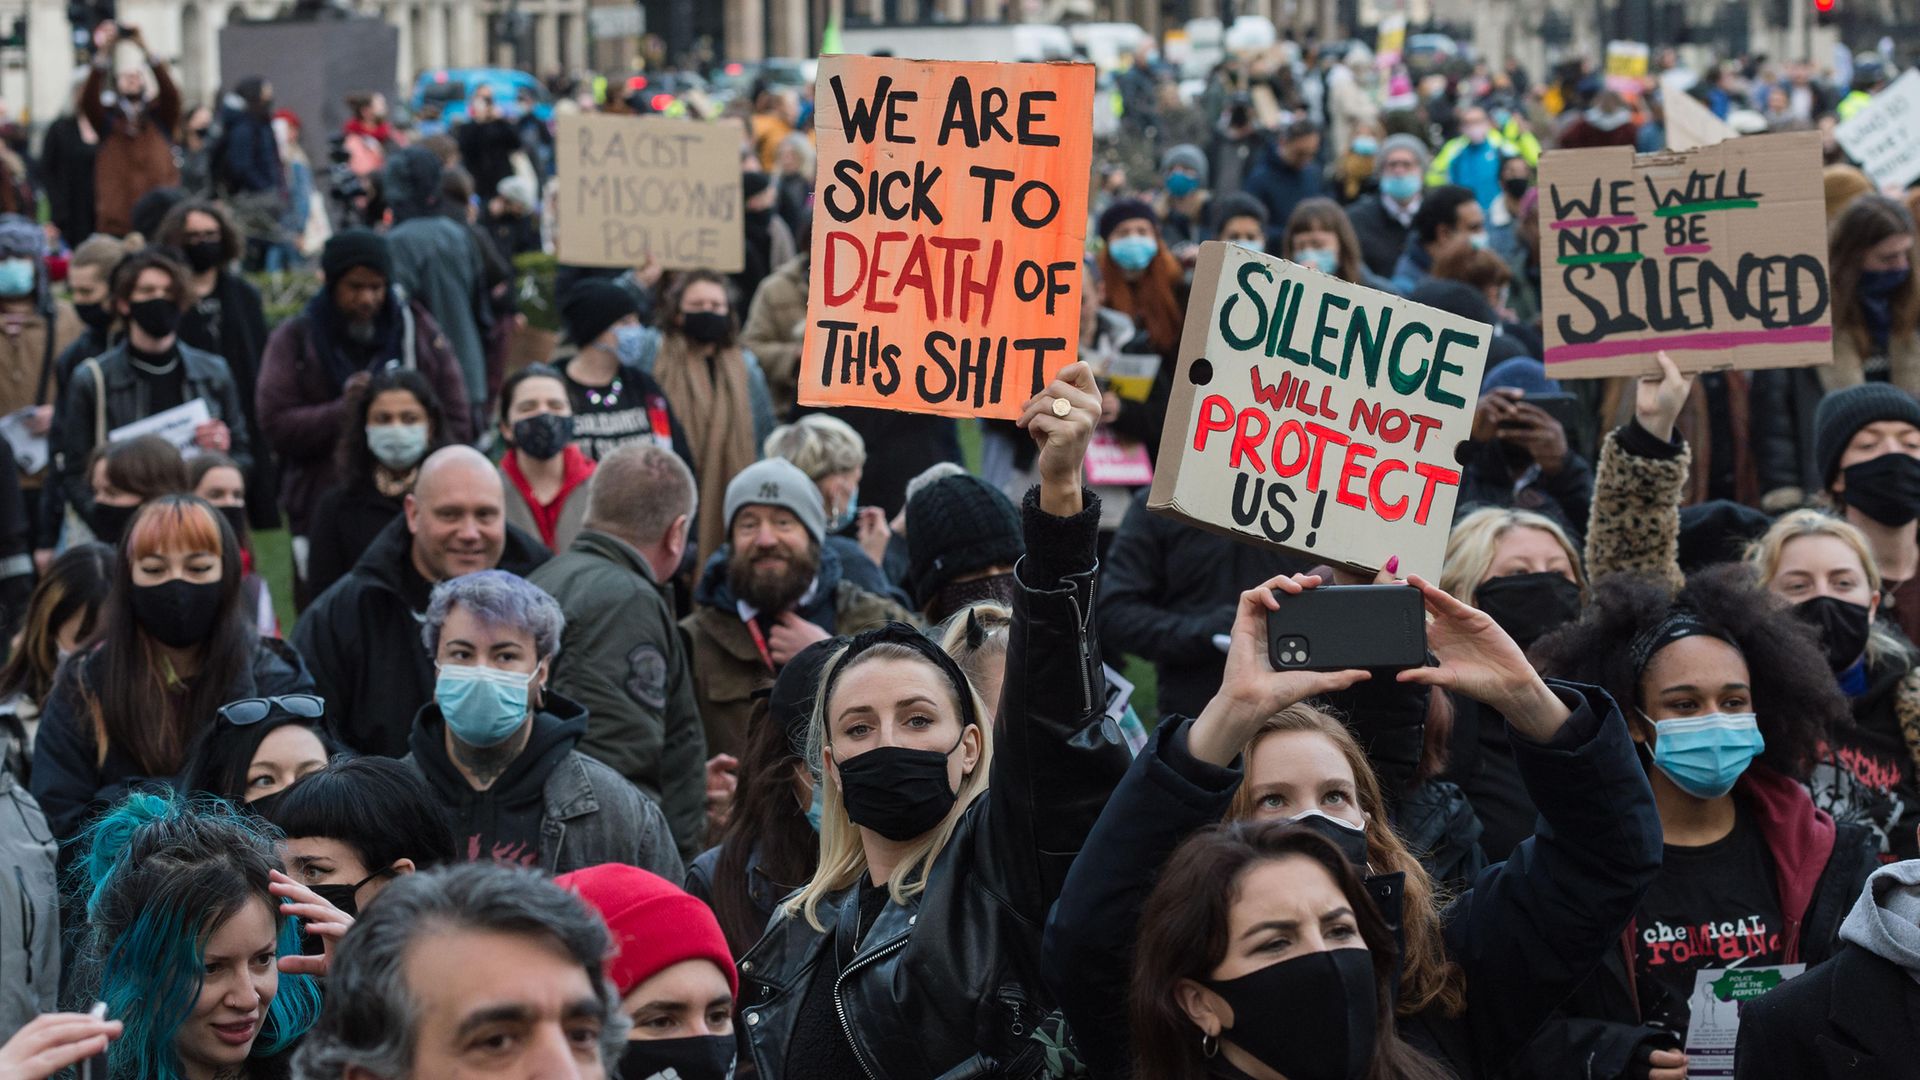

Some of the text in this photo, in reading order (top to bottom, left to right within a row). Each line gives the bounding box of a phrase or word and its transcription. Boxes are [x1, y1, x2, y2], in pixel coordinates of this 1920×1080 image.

[829, 75, 1060, 148] WE ARE
[823, 160, 1060, 229] SICK TO
[1550, 168, 1764, 221] WE WILL
[601, 219, 720, 263] POLICE
[1558, 214, 1709, 257] NOT BE
[823, 231, 1076, 327] DEATH OF
[1557, 252, 1829, 345] SILENCED
[816, 319, 1067, 408] THIS SHIT
[1219, 261, 1480, 409] SILENCE
[1250, 364, 1443, 453] WILL NOT
[1193, 394, 1461, 526] PROTECT
[1749, 980, 1764, 988] THE
